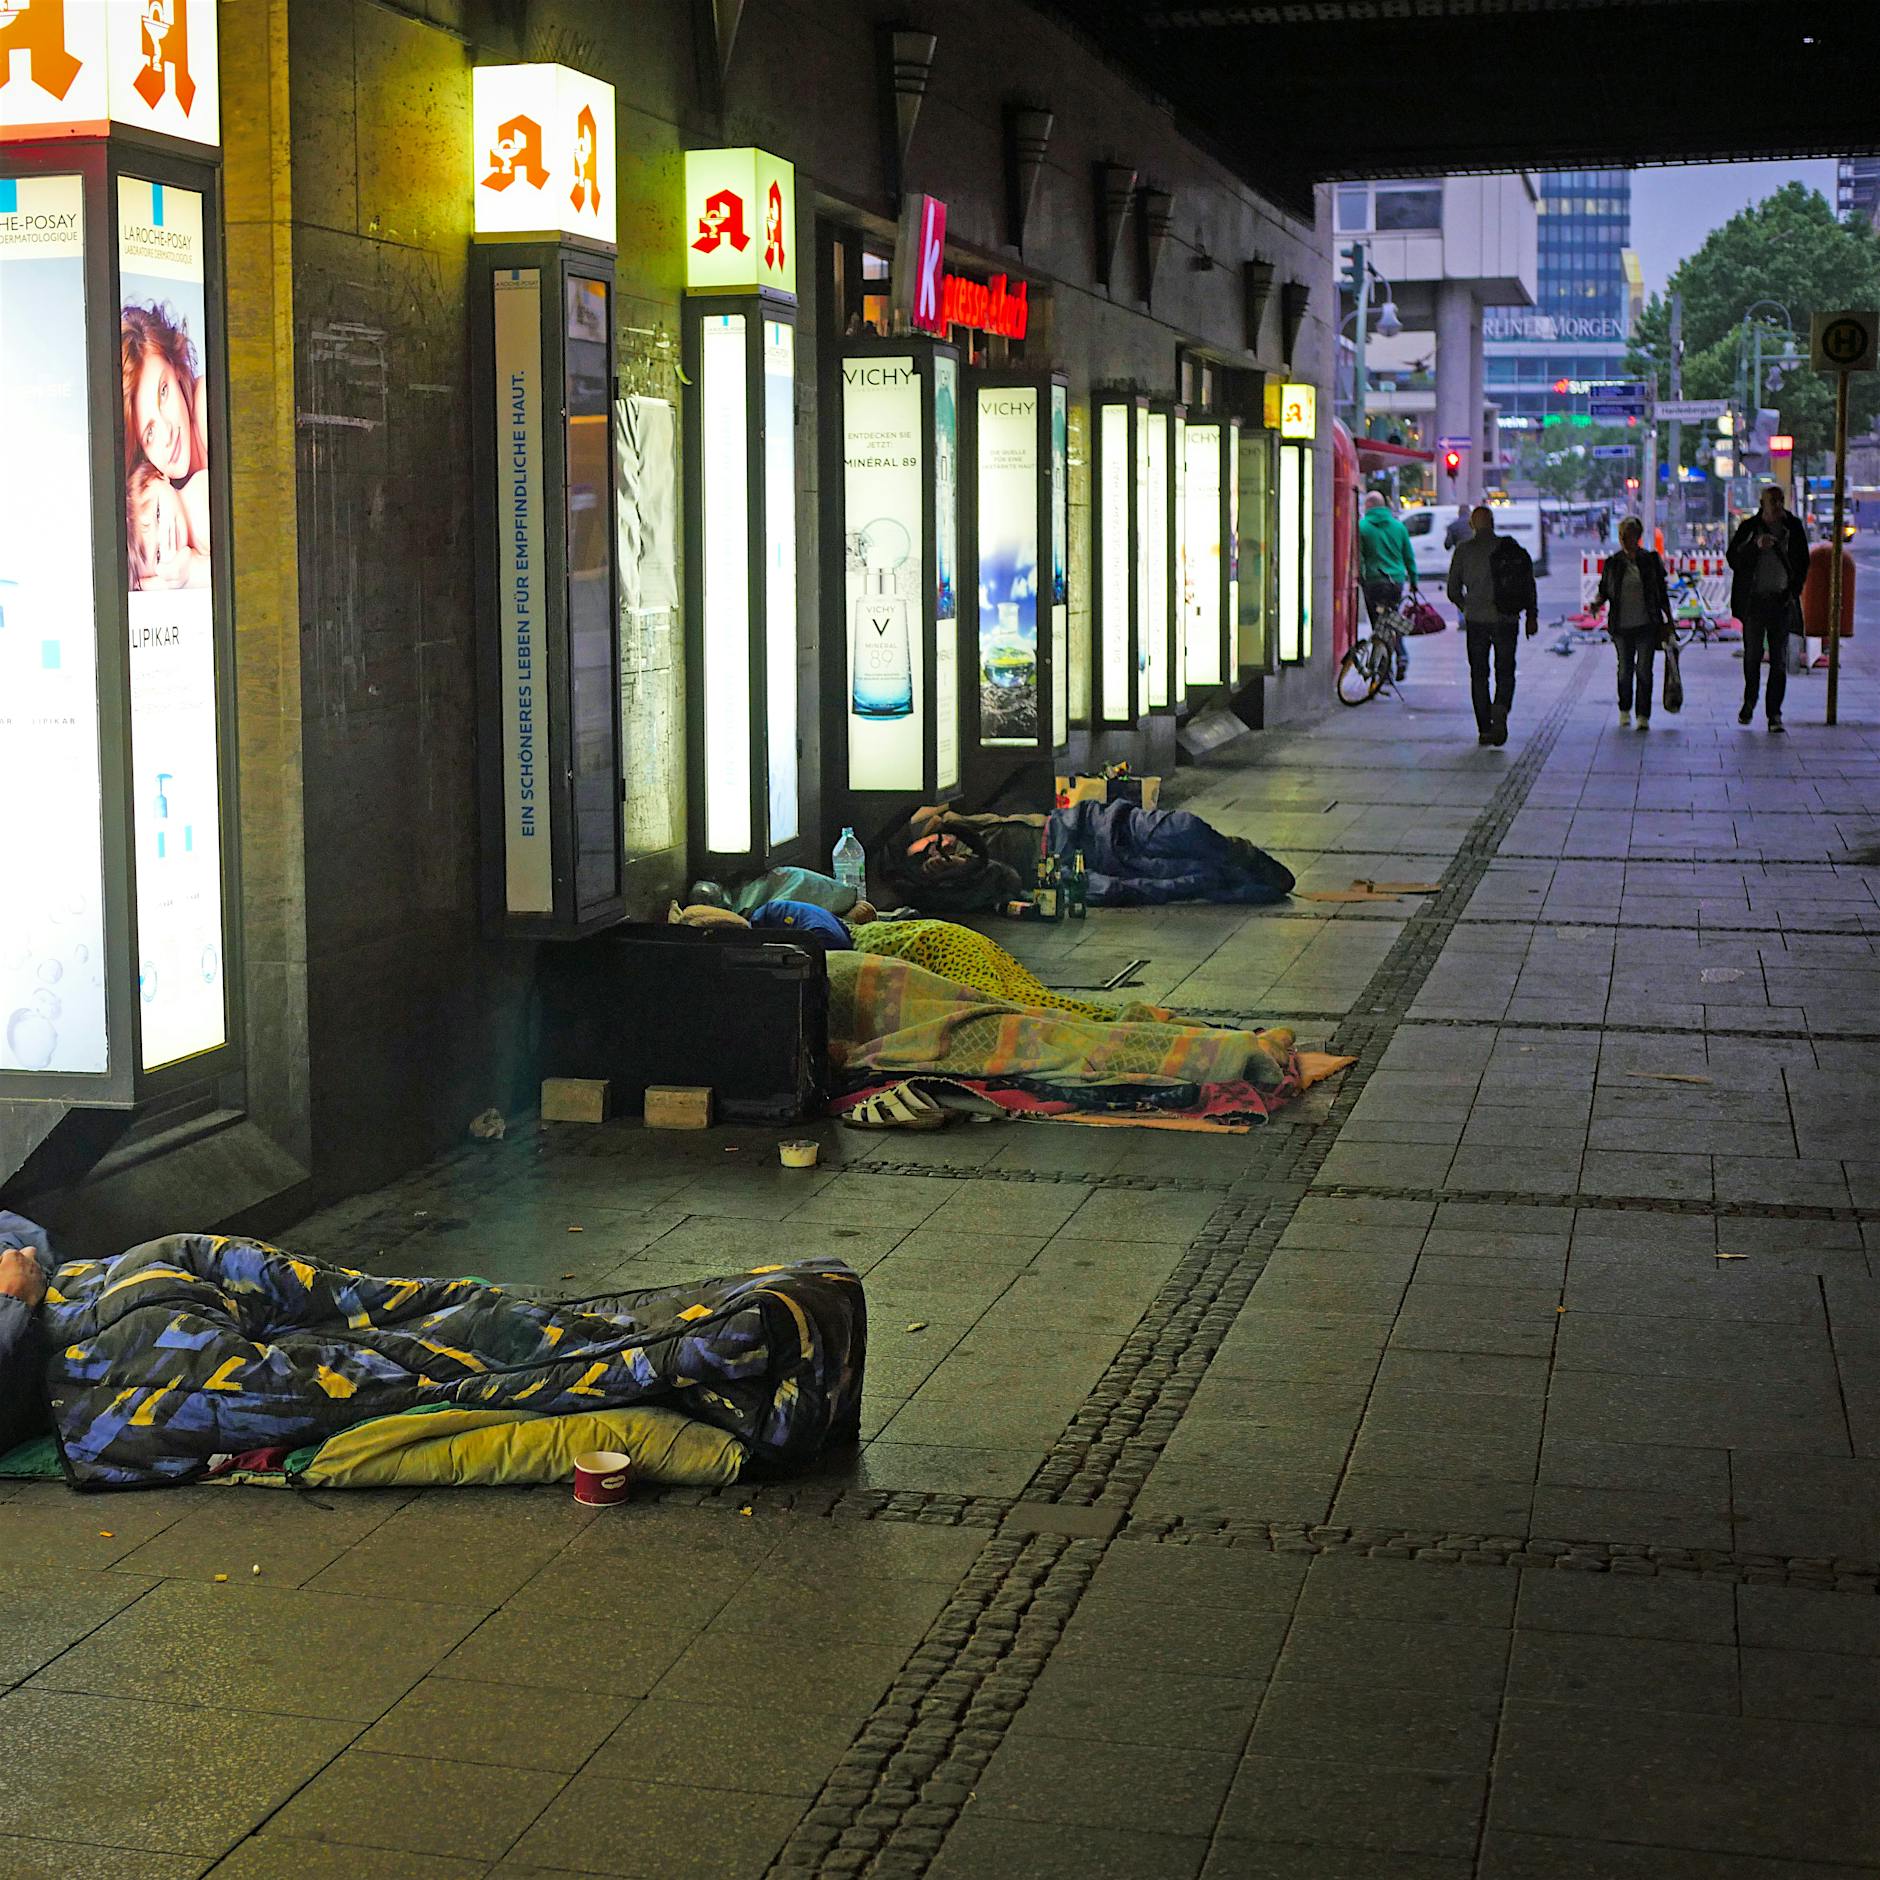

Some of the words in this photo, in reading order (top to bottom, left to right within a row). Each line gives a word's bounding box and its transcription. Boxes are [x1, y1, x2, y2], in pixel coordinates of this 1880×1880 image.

[124, 225, 136, 241] LA
[136, 228, 192, 250] ROCHE-POSAY
[842, 368, 914, 386] VICHY
[511, 370, 525, 424] HAUT.
[981, 402, 1036, 416] VICHY
[1187, 431, 1219, 444] ICHY
[902, 457, 917, 467] 89
[513, 429, 529, 570] EMPFINDLICHE
[514, 570, 530, 615] FÜR
[131, 626, 180, 648] LIPIKAR
[517, 620, 531, 680] LEBEN
[517, 685, 534, 800] SCHÖNERES
[522, 806, 535, 836] EIN
